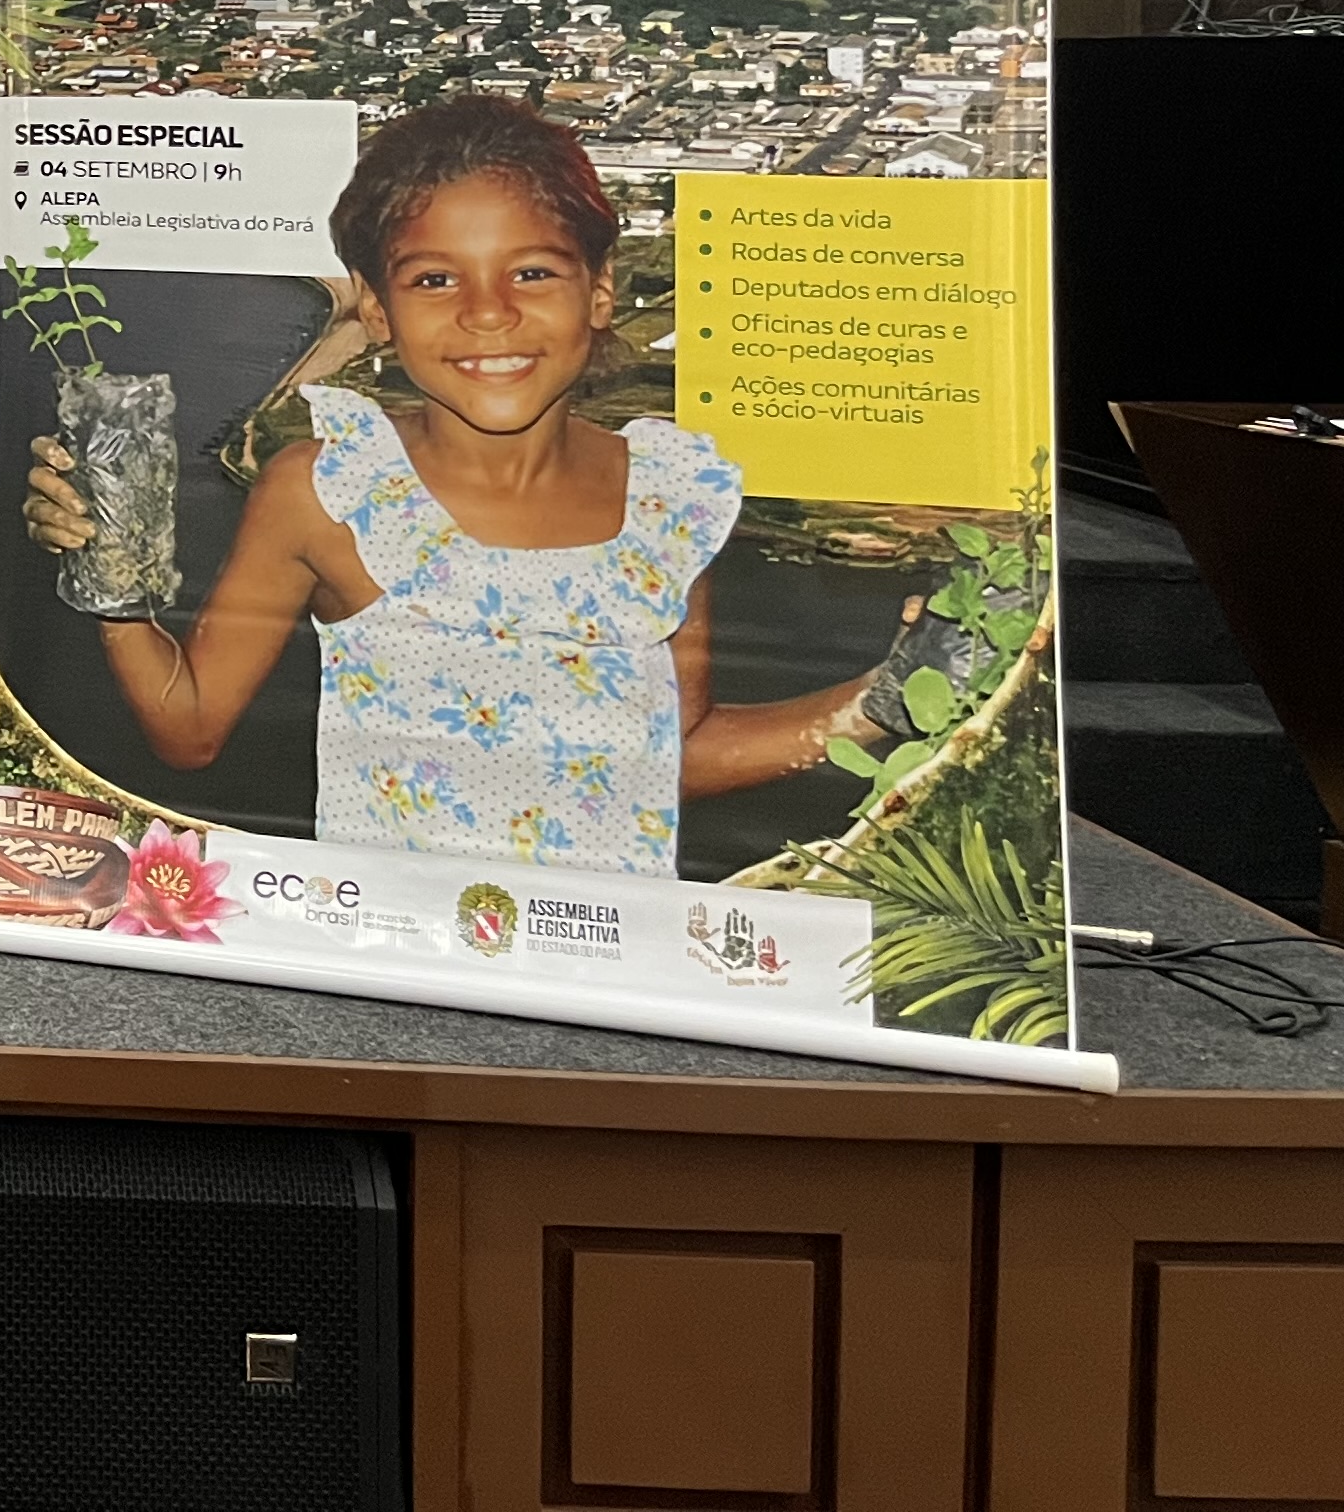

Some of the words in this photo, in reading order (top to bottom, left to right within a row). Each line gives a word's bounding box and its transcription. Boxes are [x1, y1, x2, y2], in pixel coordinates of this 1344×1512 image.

[15, 118, 112, 146] SESSÃO
[118, 124, 244, 149] ESPECIAL
[40, 160, 67, 178] 04
[72, 161, 197, 180] SETEMBRO
[214, 163, 242, 182] 9h
[40, 191, 100, 207] ALEPA
[40, 210, 142, 229] Assembleia
[146, 211, 241, 232] Legislativa
[245, 215, 269, 231] do
[273, 217, 314, 233] Pará
[731, 207, 797, 228] Artes
[803, 208, 835, 228] da
[839, 209, 892, 229] vida
[731, 242, 807, 263] Rodas
[812, 243, 845, 264] de
[850, 250, 965, 267] conversa
[731, 277, 870, 301] Deputados
[876, 285, 918, 302] em
[923, 283, 1017, 309] diálogo
[731, 313, 833, 336] Oficinas
[839, 316, 871, 337] de
[877, 321, 947, 340] curas
[952, 324, 968, 340] e
[731, 340, 935, 368] eco-pedagogias
[731, 375, 806, 397] Ações
[811, 380, 981, 404] comunitárias
[731, 400, 746, 417] e
[752, 397, 925, 424] sócio-virtuais
[305, 905, 360, 928] brasil
[527, 898, 620, 924] ASSEMBLEIA
[527, 917, 621, 945] LEGISLATIVA
